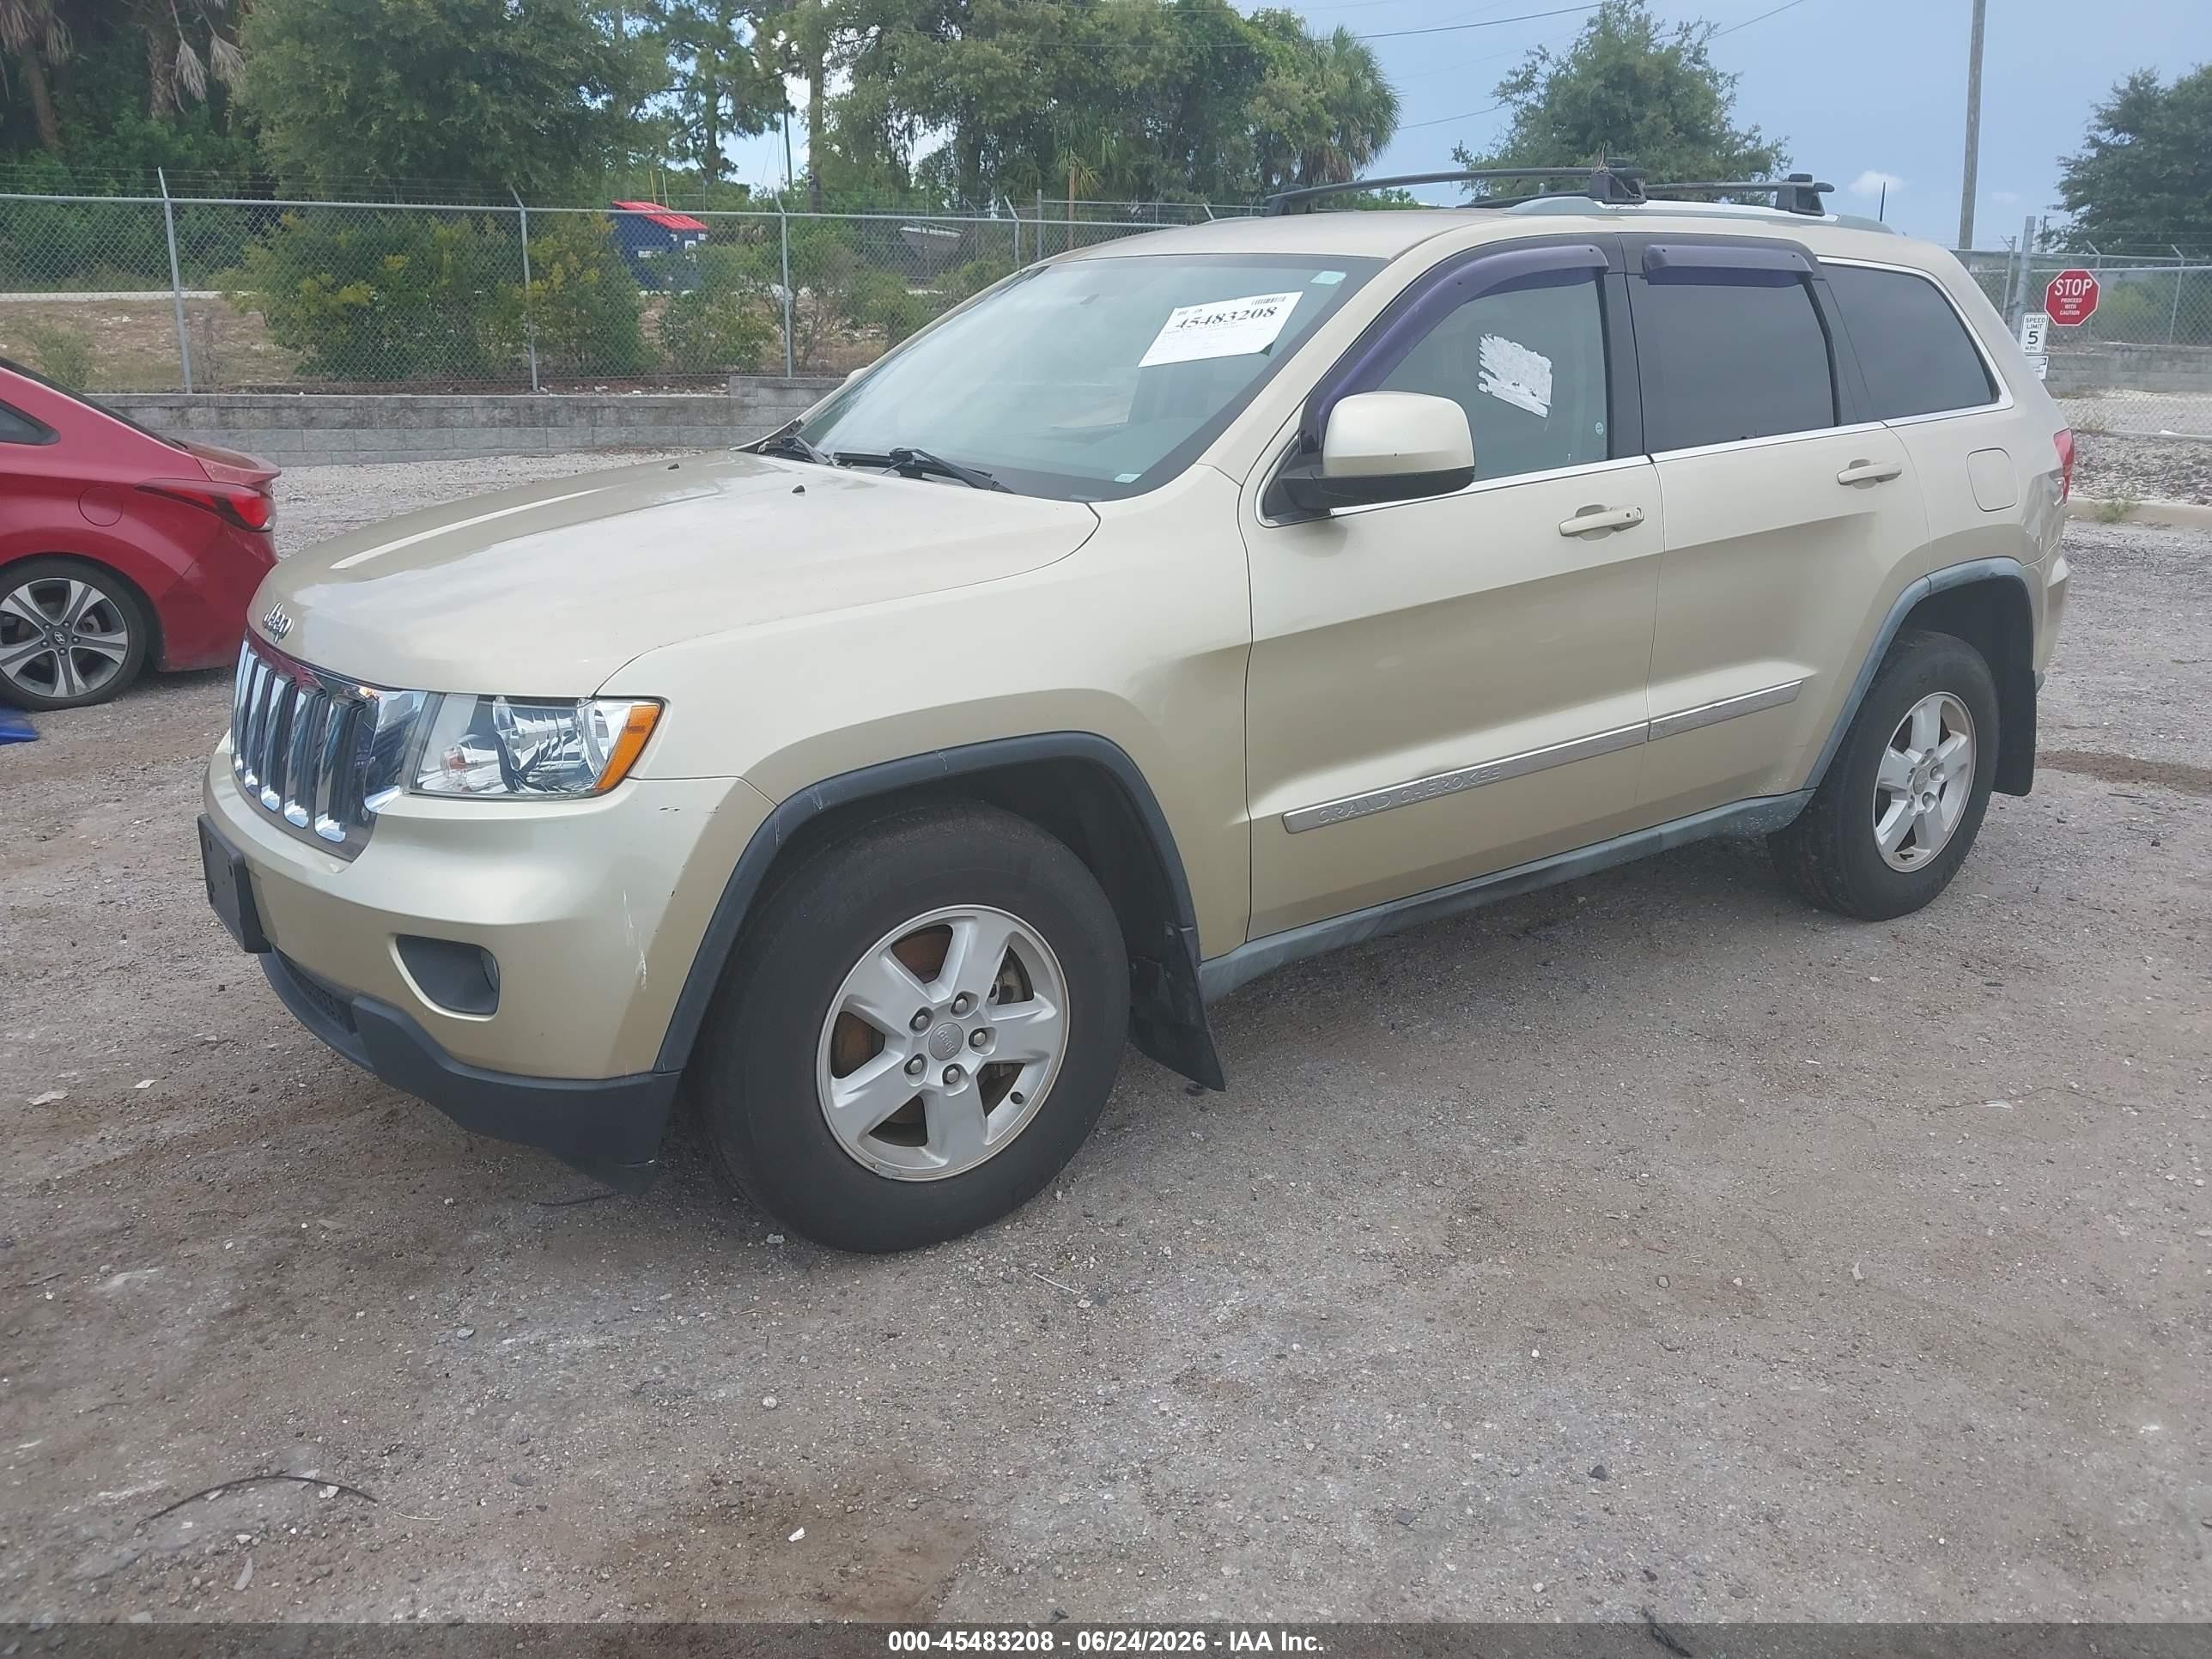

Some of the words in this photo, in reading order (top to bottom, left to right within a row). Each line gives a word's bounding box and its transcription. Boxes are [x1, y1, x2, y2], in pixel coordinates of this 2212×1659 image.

[2055, 279, 2093, 295] STOP
[1176, 306, 1278, 329] 45483208
[2027, 331, 2039, 344] 5
[262, 601, 295, 644] Jeep
[1318, 794, 1391, 823] GRAND
[1401, 766, 1501, 803] CHEROKEE
